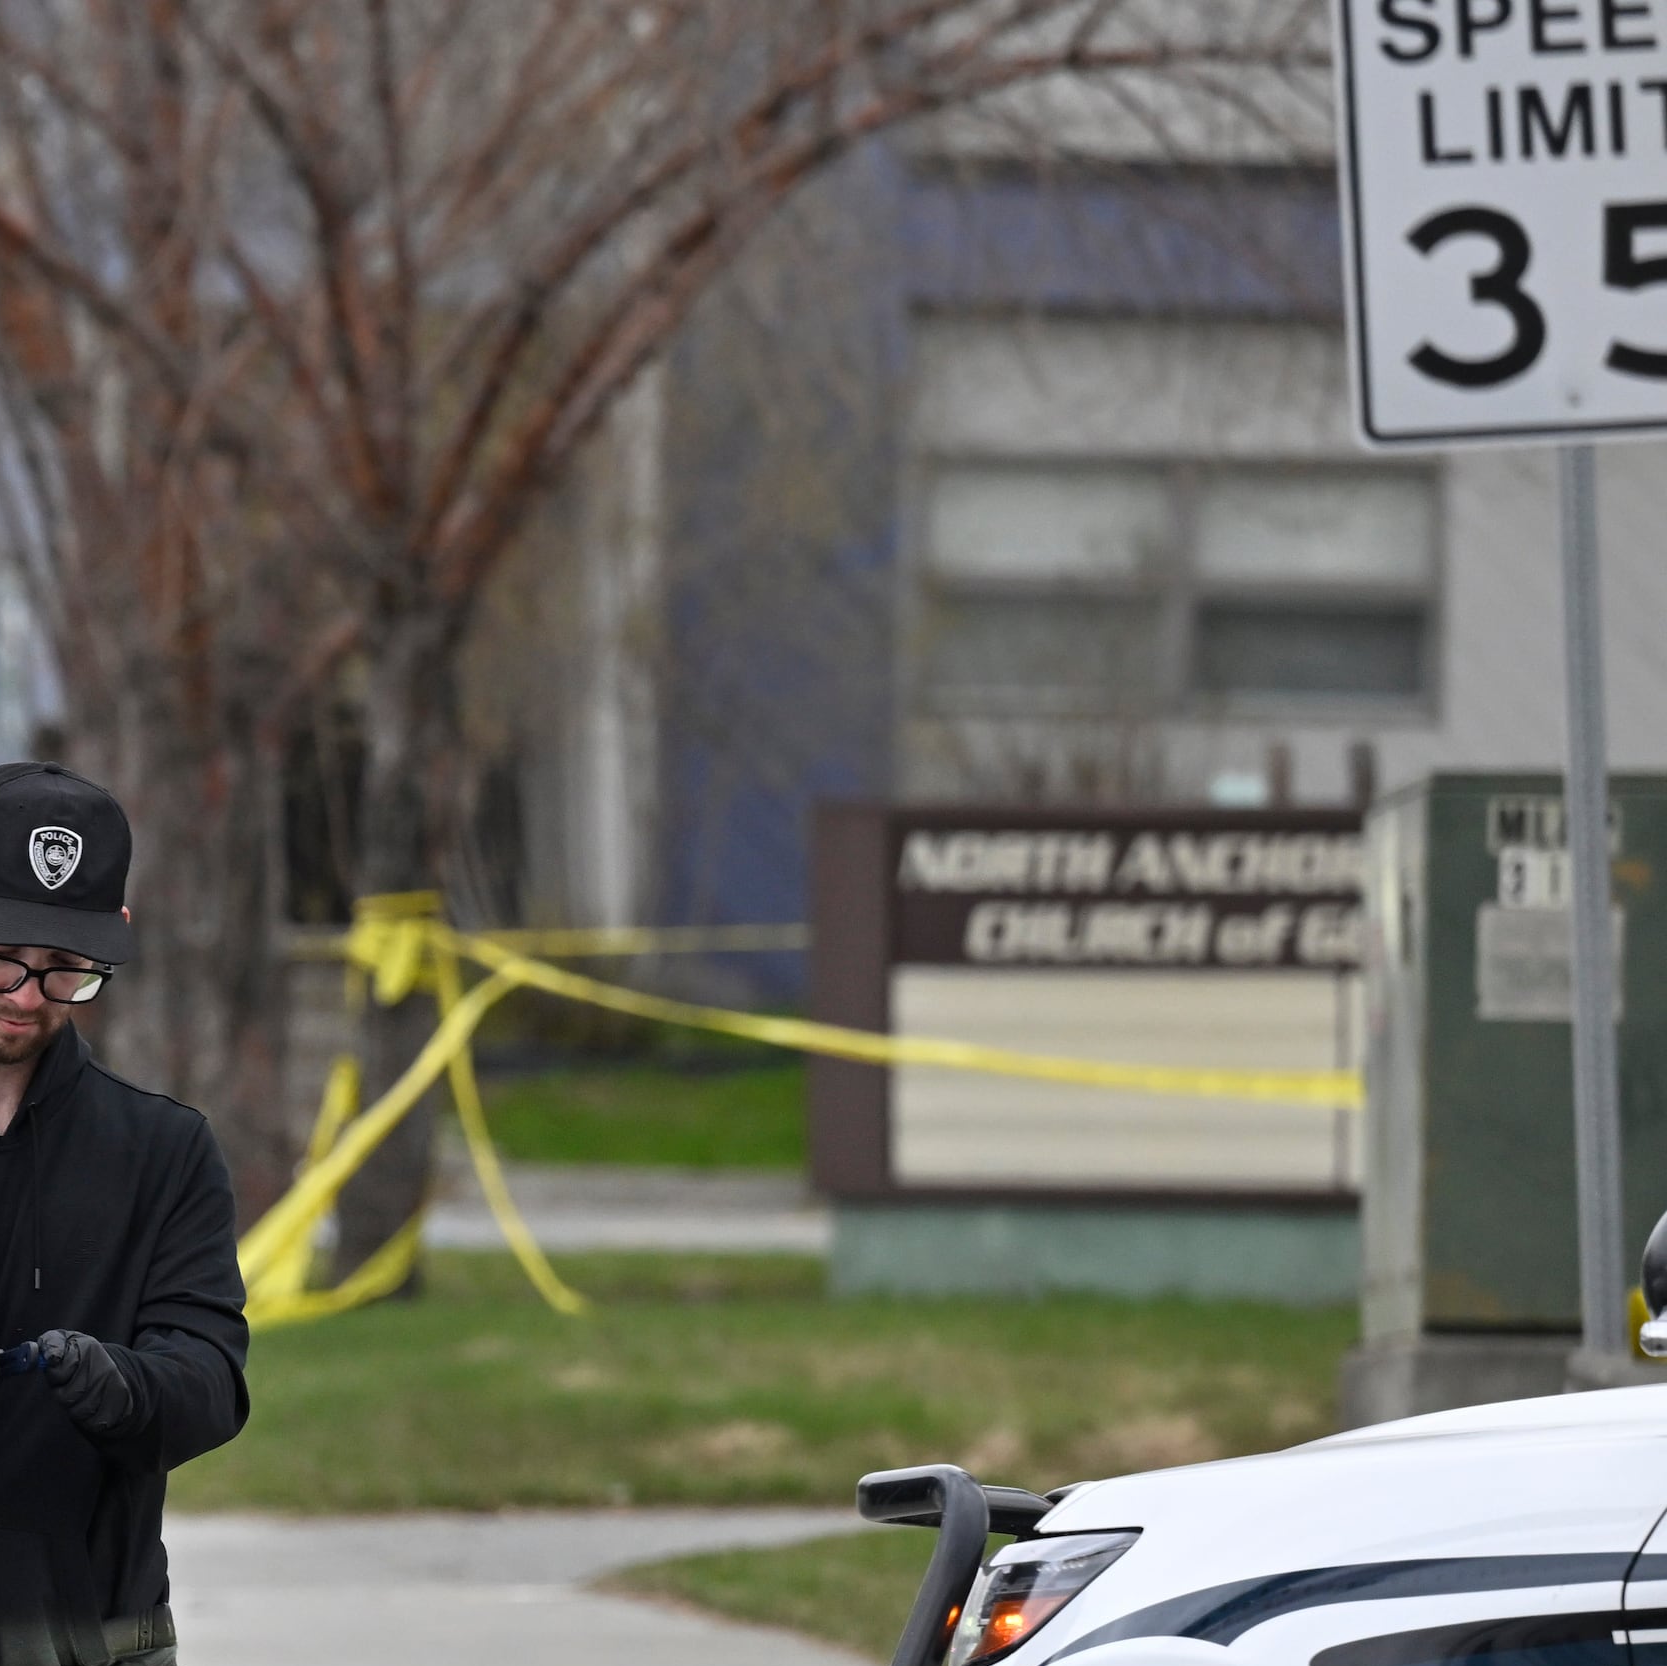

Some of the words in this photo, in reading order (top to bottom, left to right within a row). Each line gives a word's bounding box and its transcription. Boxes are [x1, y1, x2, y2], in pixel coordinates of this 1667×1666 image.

[40, 832, 74, 846] POLICE
[897, 829, 1116, 894] NORTH
[964, 901, 1213, 963] CHURCH
[1215, 902, 1295, 963] of
